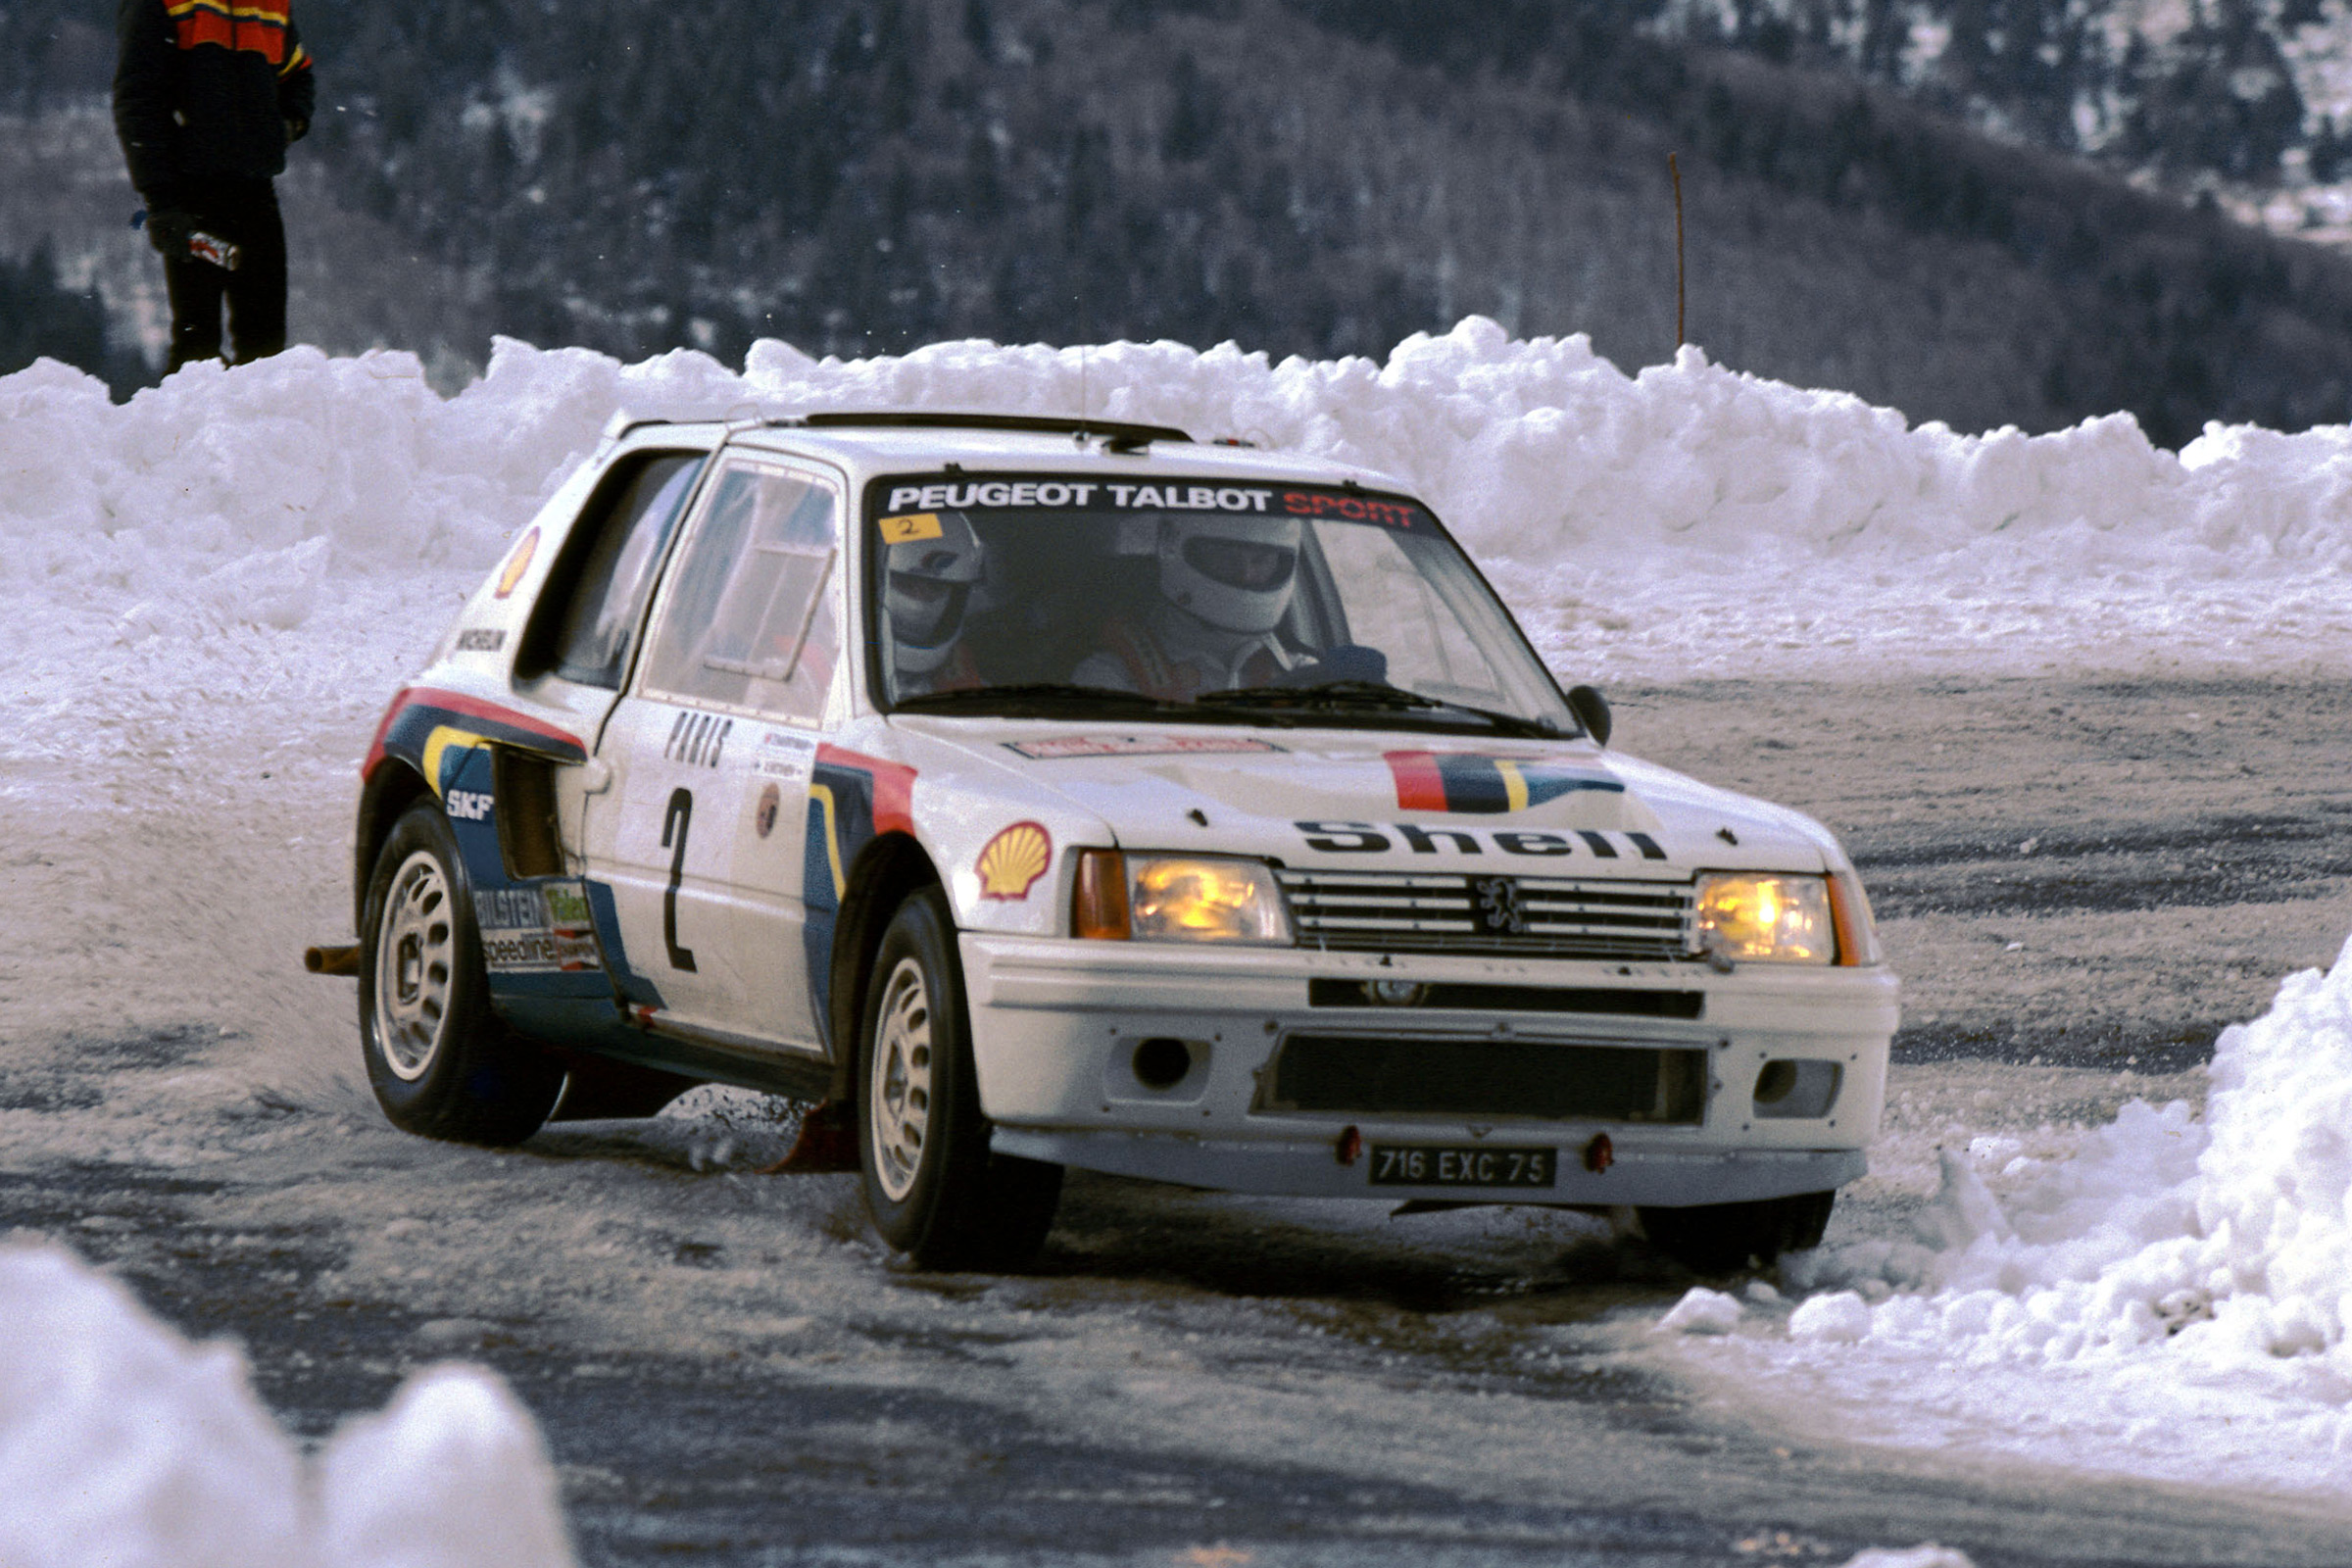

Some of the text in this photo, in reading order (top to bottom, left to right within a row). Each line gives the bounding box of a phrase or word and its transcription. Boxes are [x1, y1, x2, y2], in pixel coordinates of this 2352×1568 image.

[888, 482, 1415, 528] PEUGEOT TALBOT SPORT
[896, 518, 919, 536] 2
[446, 789, 495, 820] SKF
[1293, 820, 1668, 860] Shell
[661, 787, 698, 973] 2
[1379, 1150, 1545, 1184] 716 EXC 75
